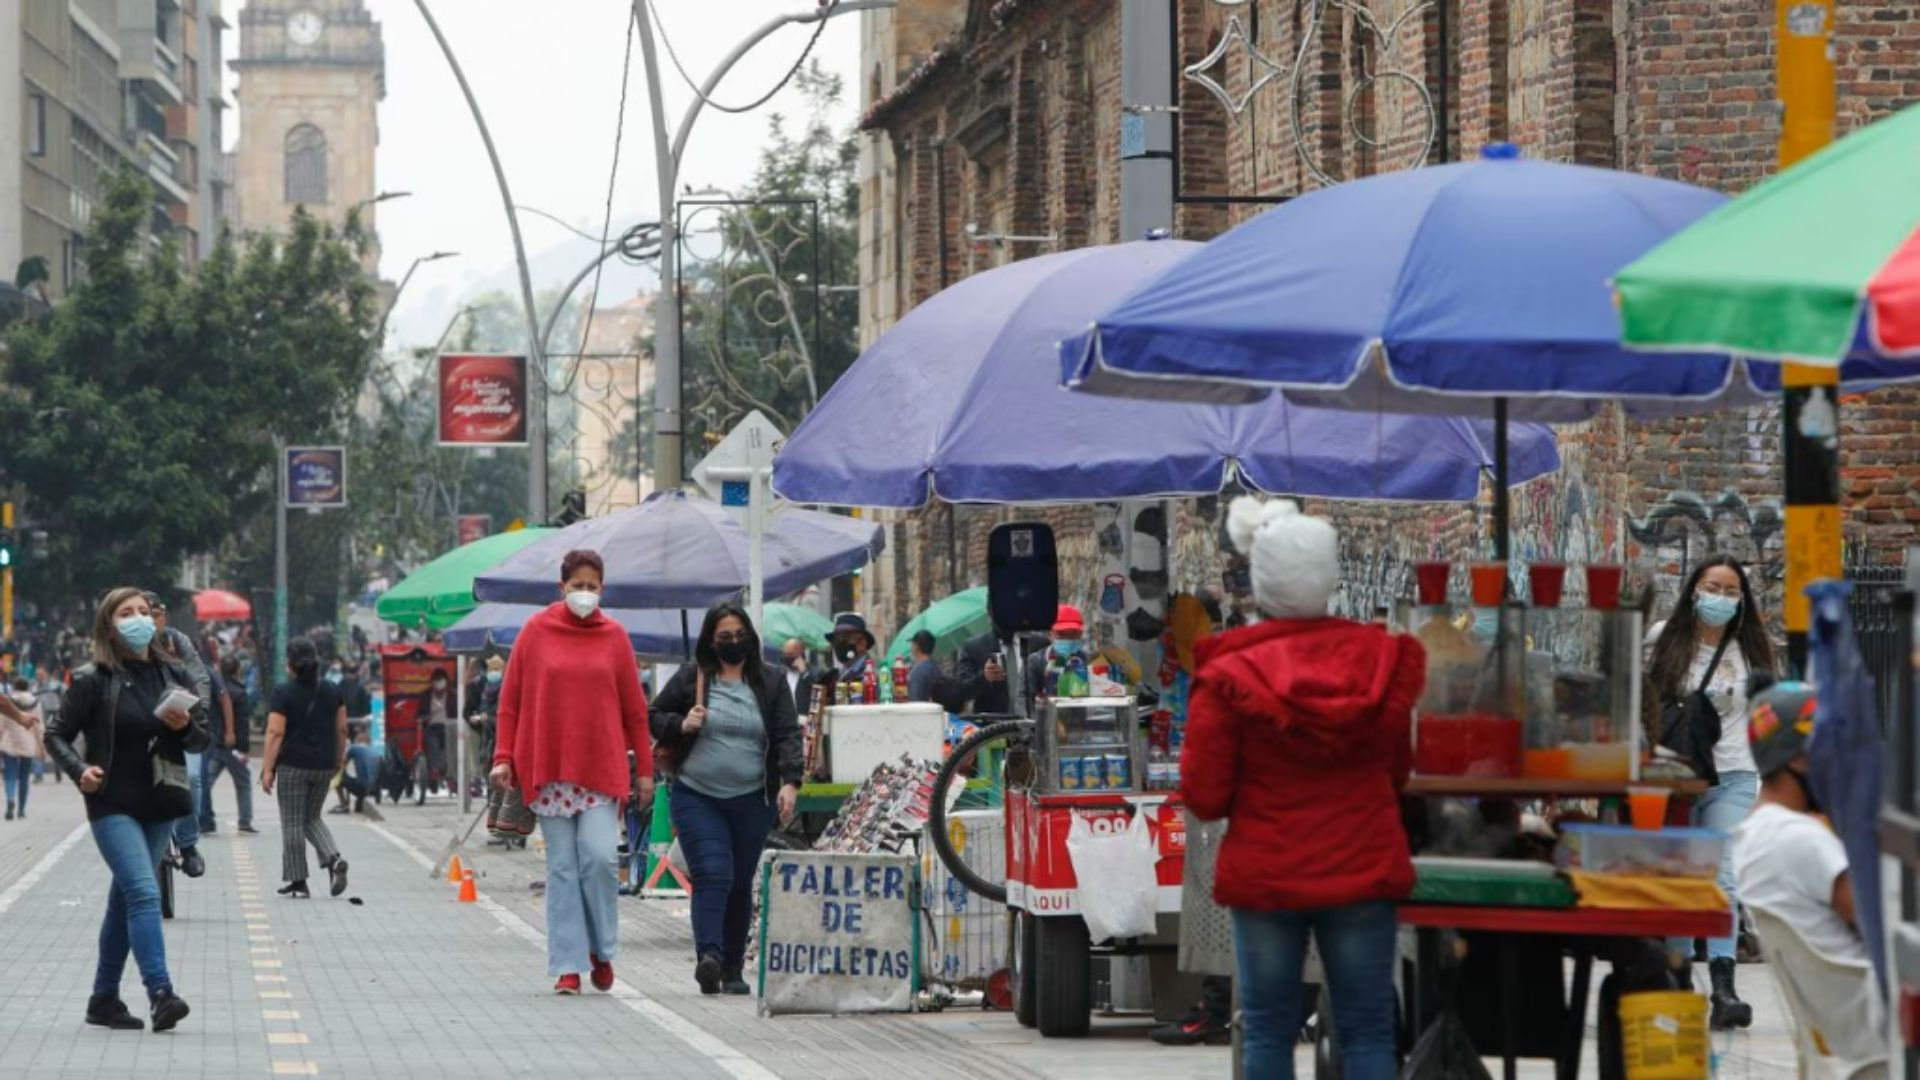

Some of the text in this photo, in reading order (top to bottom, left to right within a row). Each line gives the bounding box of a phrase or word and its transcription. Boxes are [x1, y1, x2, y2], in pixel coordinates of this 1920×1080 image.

[779, 862, 904, 899] TALLER
[822, 901, 862, 933] DE
[769, 942, 909, 979] BICICLETAS
